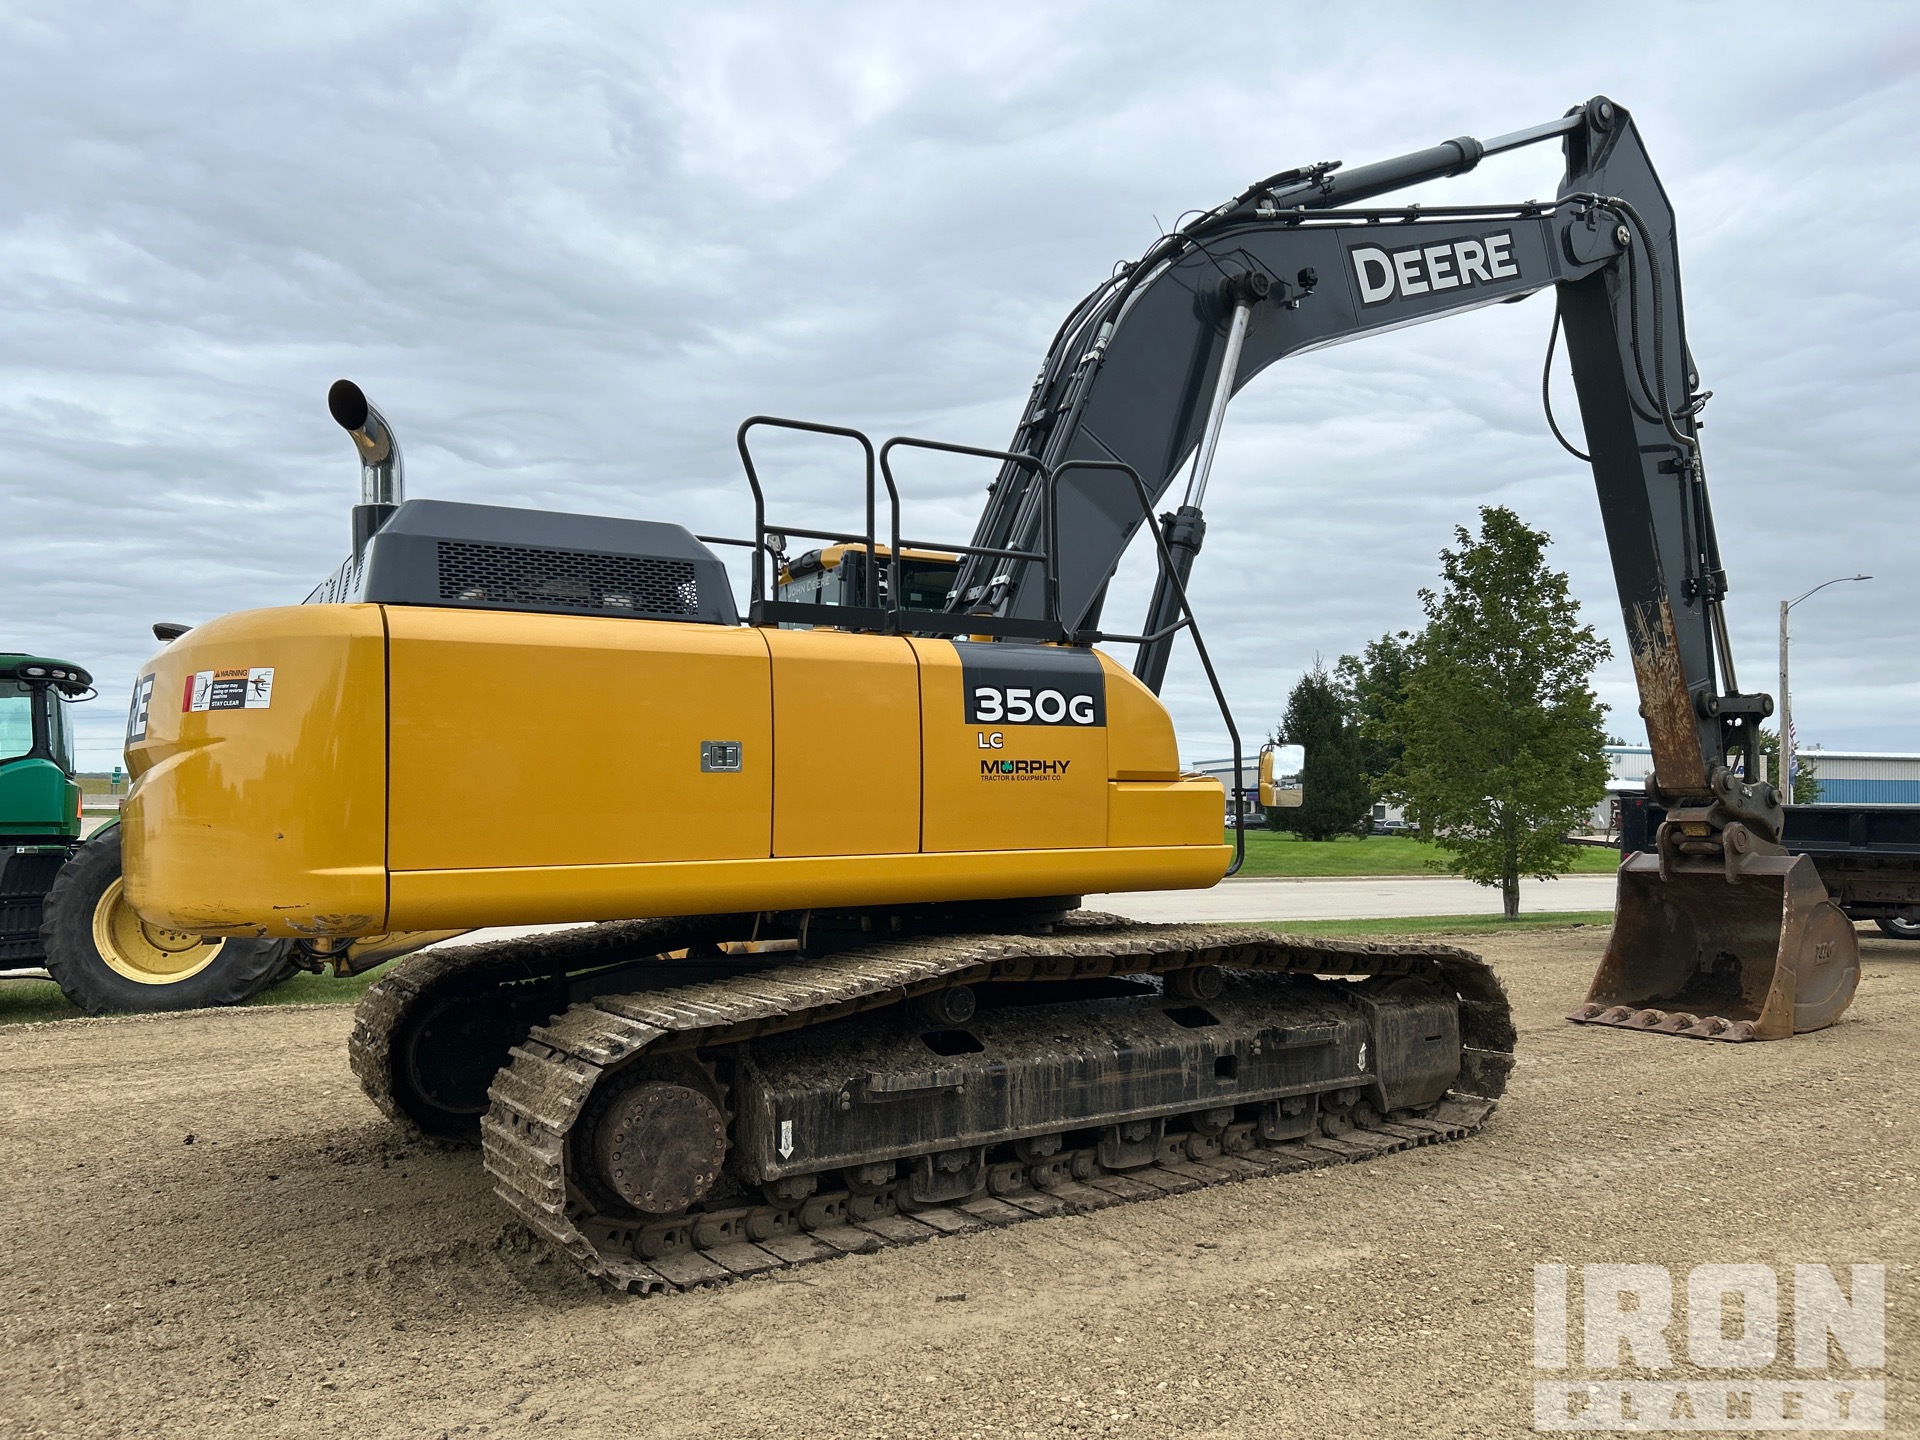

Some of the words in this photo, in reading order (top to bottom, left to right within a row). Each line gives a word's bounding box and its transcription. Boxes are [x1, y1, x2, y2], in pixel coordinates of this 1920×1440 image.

[1351, 233, 1518, 304] DEERE
[788, 584, 806, 598] JOHN
[807, 576, 830, 591] DEERE
[221, 669, 247, 677] WARNING
[975, 687, 1094, 724] 350G
[978, 732, 1003, 748] LC
[980, 760, 1071, 774] MURPHY
